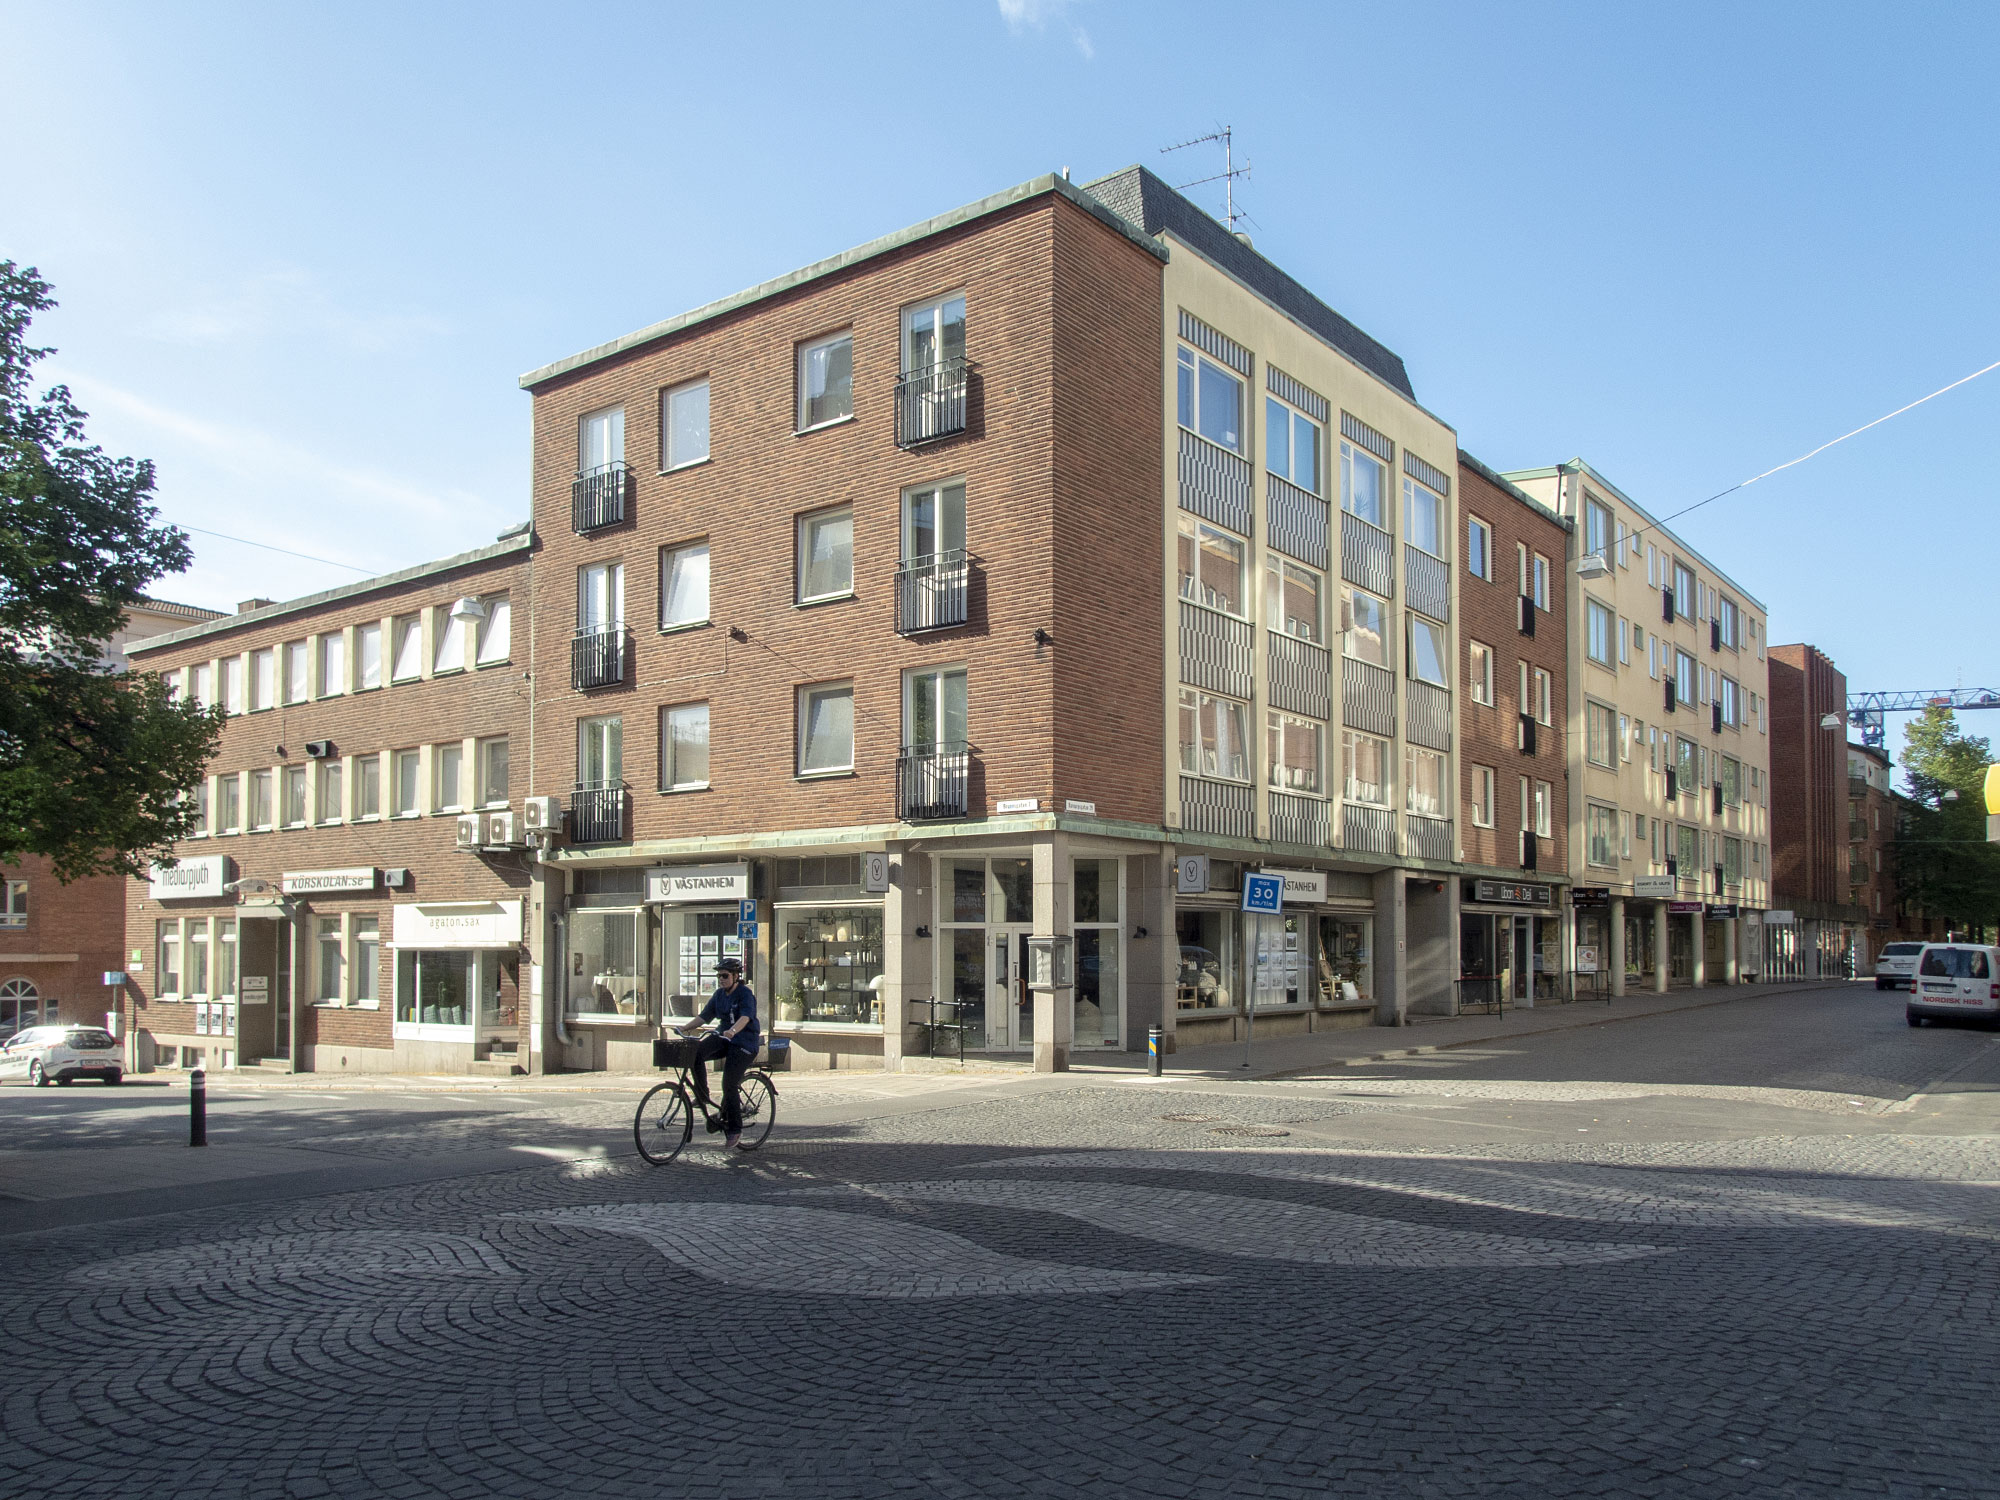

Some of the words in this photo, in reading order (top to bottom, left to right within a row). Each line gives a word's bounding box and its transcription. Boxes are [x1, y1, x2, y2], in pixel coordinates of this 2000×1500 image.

[162, 863, 209, 891] mediaspjuth
[291, 875, 364, 890] KÖRSKOLAN.se
[1257, 879, 1271, 887] max
[674, 877, 735, 890] VÄSTANHEM
[1284, 877, 1317, 892] ÄSTANHEM
[1253, 888, 1274, 899] 30
[1251, 899, 1274, 907] km/tim
[744, 902, 754, 920] P
[429, 917, 480, 929] agaton.sax
[1922, 996, 1961, 1004] NORDISK
[1963, 998, 1984, 1006] HISS
